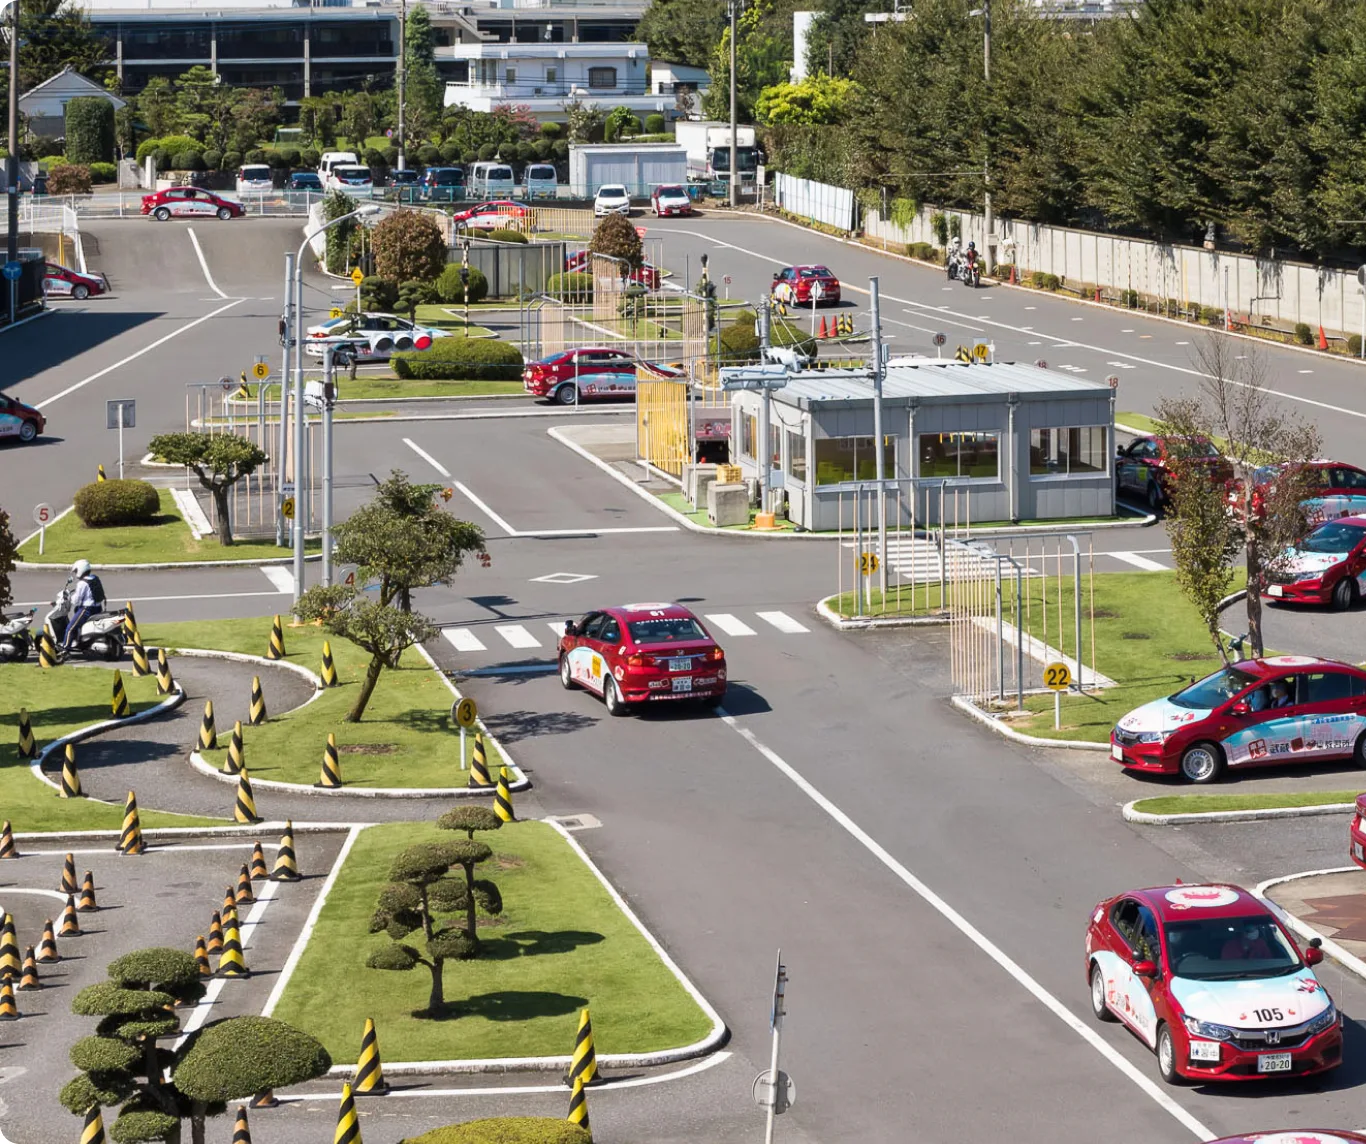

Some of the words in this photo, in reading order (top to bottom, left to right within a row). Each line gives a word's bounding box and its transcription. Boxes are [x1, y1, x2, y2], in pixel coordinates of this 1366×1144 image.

[976, 346, 986, 355] 17
[257, 366, 264, 375] 6
[1108, 377, 1119, 388] 18
[39, 508, 49, 521] 5
[861, 555, 876, 571] 24
[345, 572, 354, 585] 4
[1047, 668, 1068, 686] 22
[462, 703, 472, 722] 3
[1253, 1007, 1284, 1023] 105
[1264, 1059, 1290, 1071] 20-20
